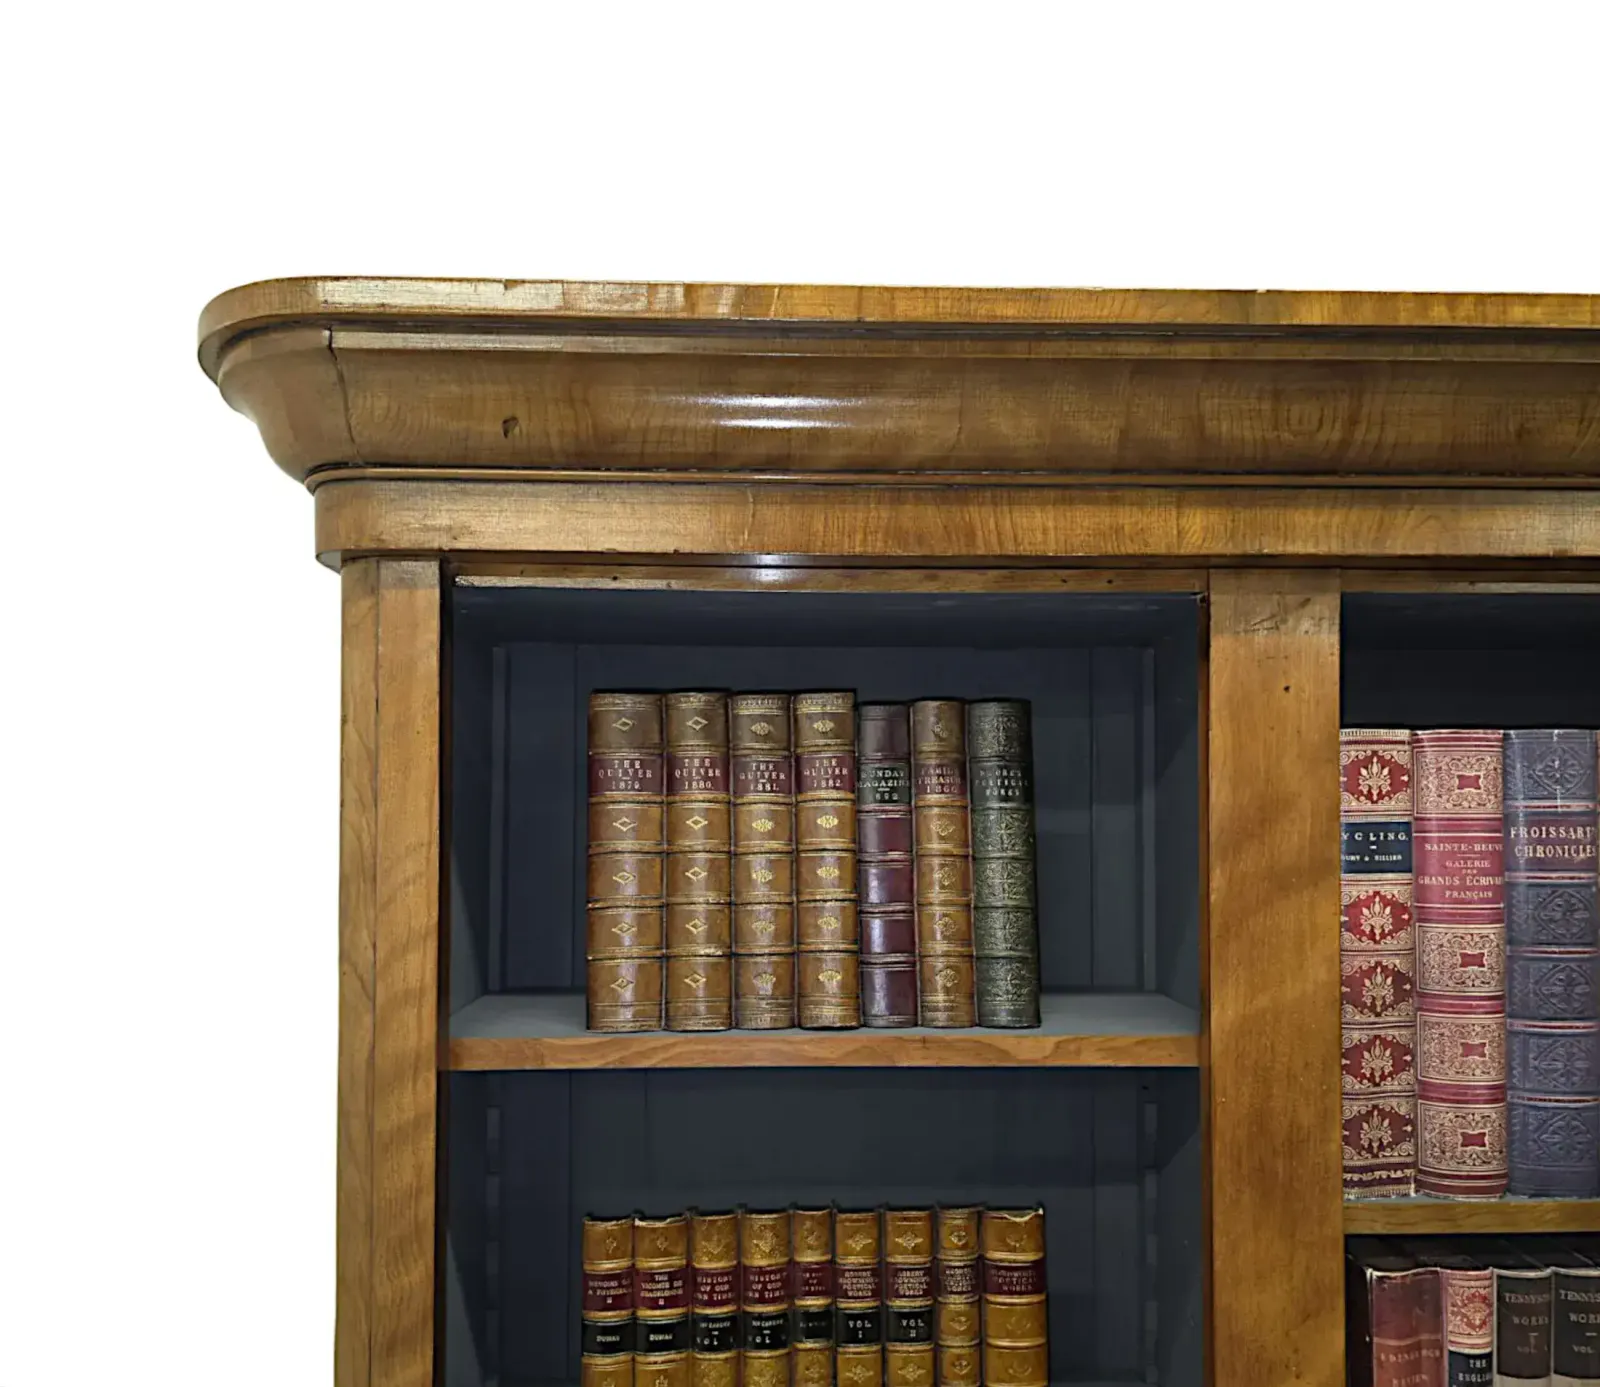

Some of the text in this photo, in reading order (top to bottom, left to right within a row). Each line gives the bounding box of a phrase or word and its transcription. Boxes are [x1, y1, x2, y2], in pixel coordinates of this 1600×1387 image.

[614, 760, 640, 768] THE
[684, 759, 710, 767] THE
[752, 762, 775, 770] THE
[816, 758, 838, 766] THE
[598, 769, 652, 778] QUIVER
[675, 768, 720, 777] QUIVER
[804, 767, 848, 776] QUIVER
[862, 770, 904, 778] SUNDAY
[740, 772, 786, 780] QUIVER
[1418, 876, 1460, 886] GRANDS
[1445, 890, 1492, 900] FRANÇAIS
